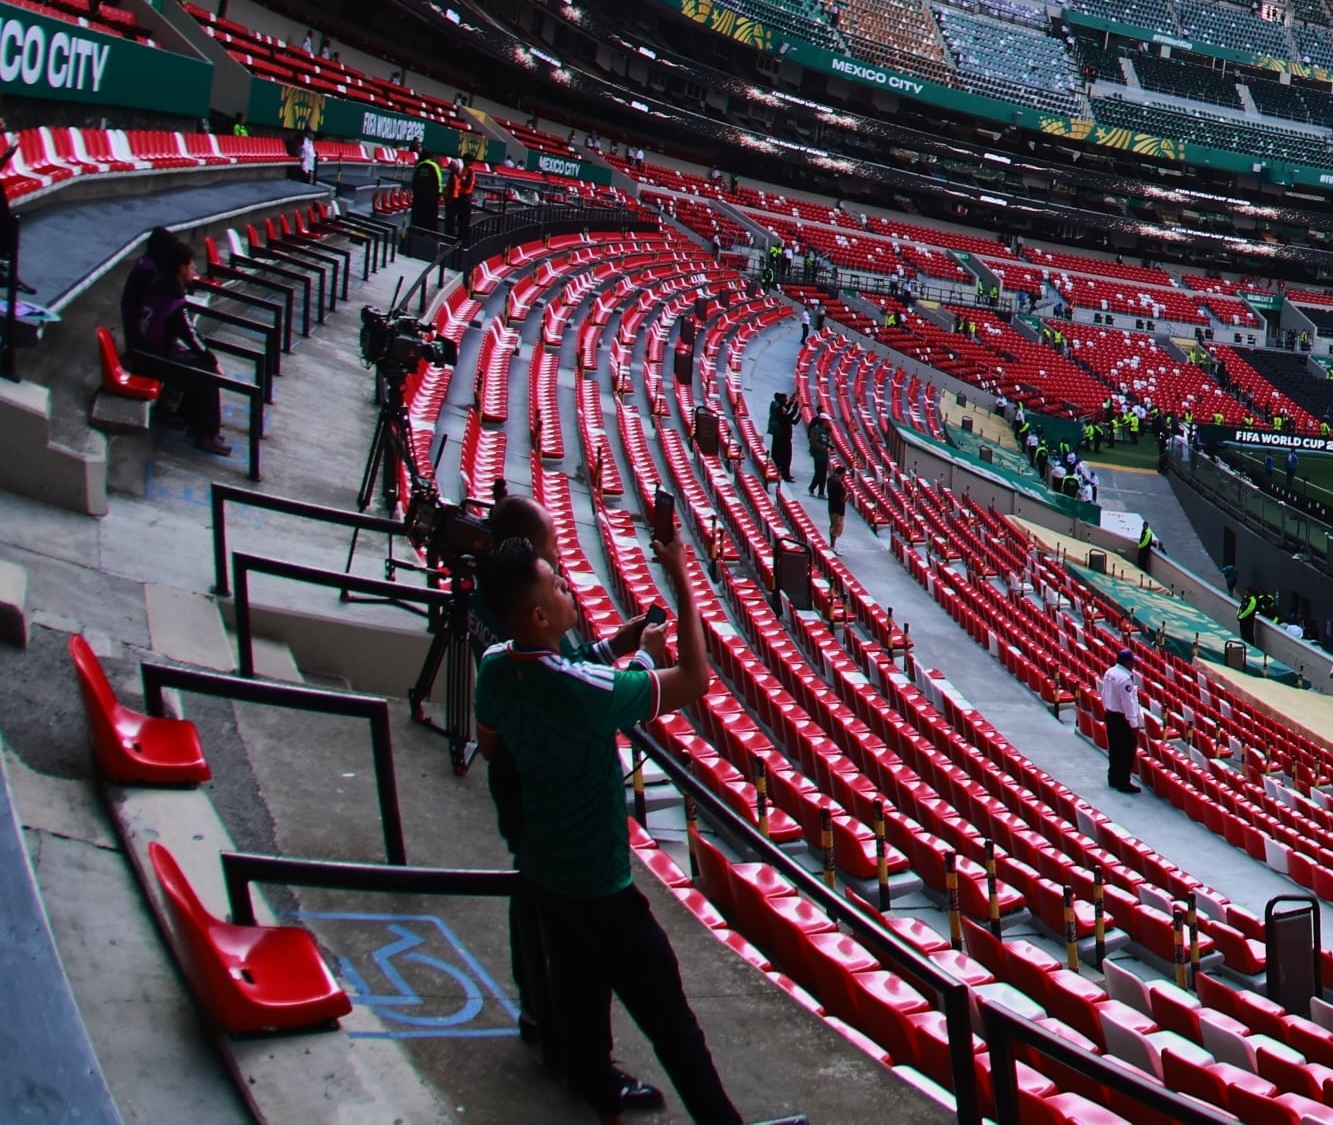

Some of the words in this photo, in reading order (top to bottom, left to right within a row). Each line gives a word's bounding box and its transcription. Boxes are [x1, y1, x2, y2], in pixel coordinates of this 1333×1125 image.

[0, 18, 45, 86] CO
[47, 32, 110, 92] CITY
[832, 58, 886, 83] MEXICO
[888, 76, 924, 94] CITY
[362, 111, 376, 136] FIFA
[539, 155, 564, 175] MEXICO
[565, 161, 580, 177] CITY
[1235, 431, 1259, 442] FIFA
[1261, 433, 1301, 446] WORLD
[1302, 438, 1324, 449] CUP
